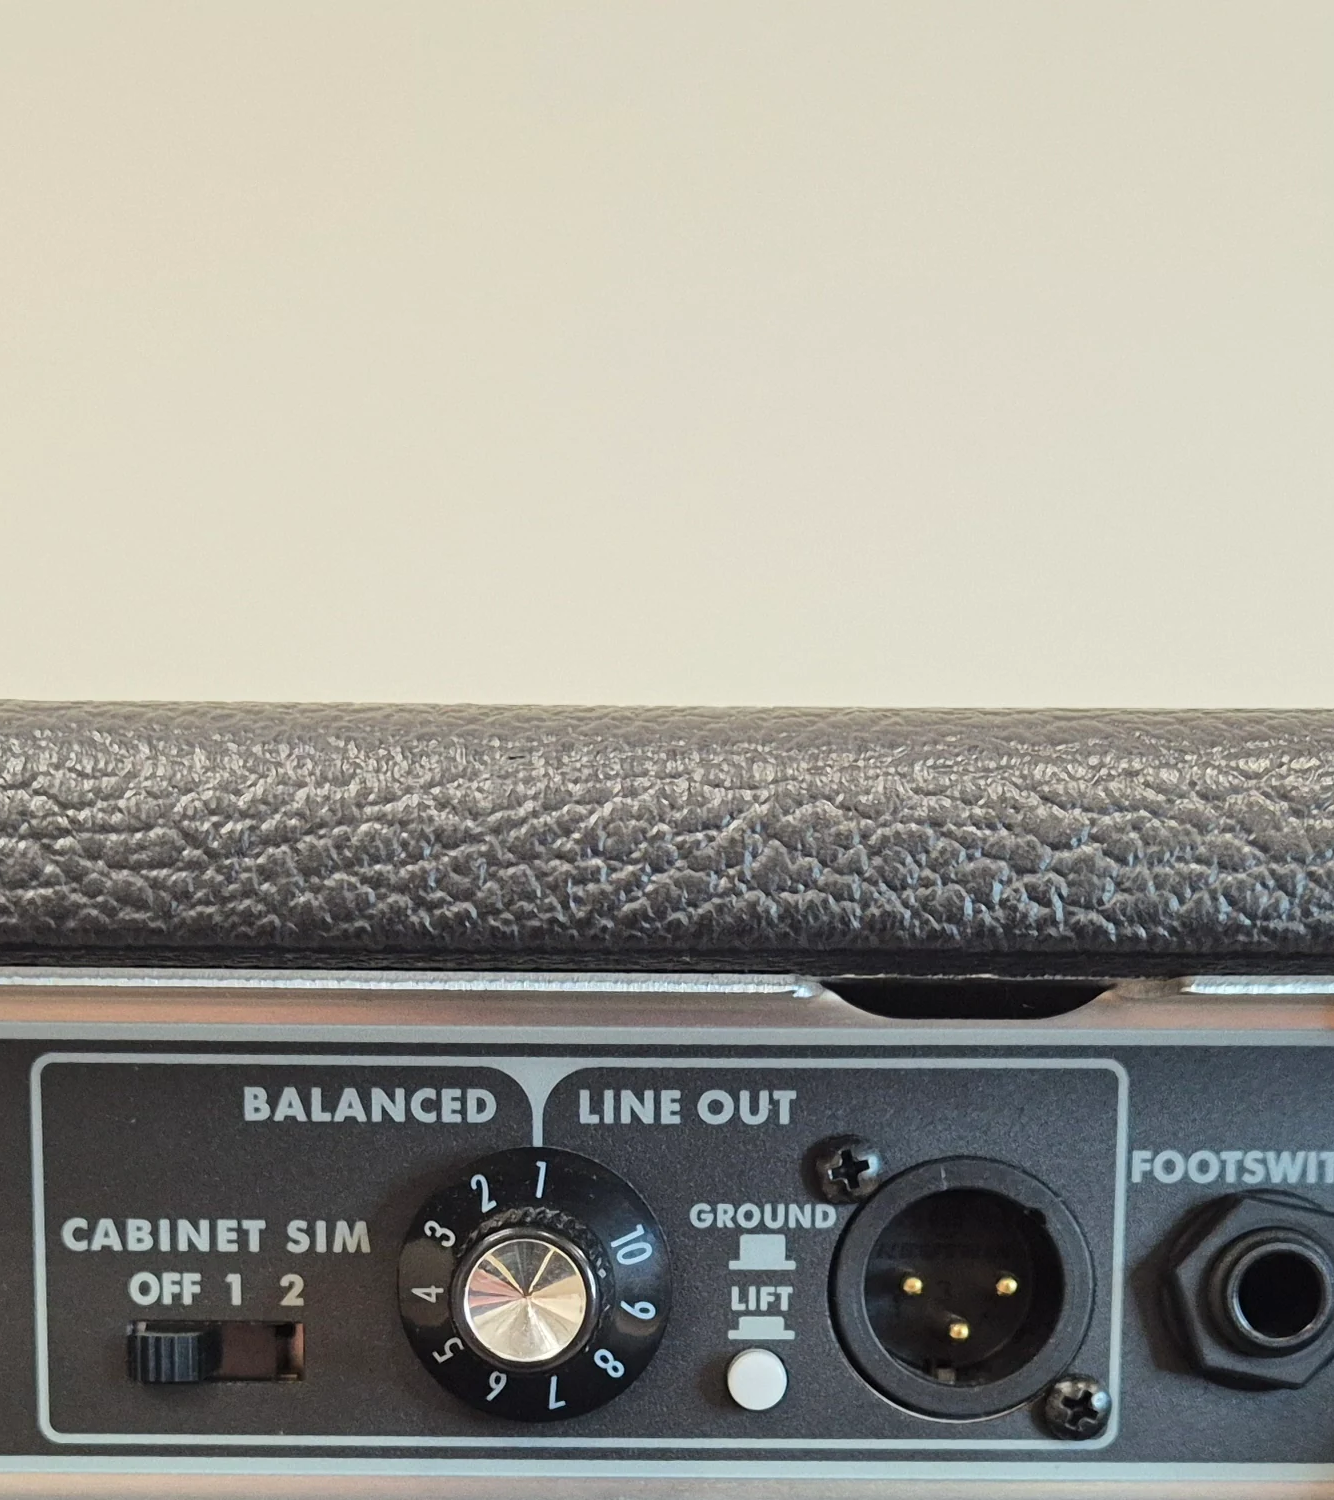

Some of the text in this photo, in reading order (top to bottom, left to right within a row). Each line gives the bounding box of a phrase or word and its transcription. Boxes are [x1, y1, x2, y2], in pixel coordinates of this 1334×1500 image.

[243, 1086, 797, 1126] BALANCED LINE OUT
[470, 1172, 499, 1214] 2
[535, 1160, 549, 1200] 1
[689, 1202, 838, 1230] GROUND
[61, 1217, 371, 1254] CABINET SIM
[424, 1219, 457, 1249] 3
[609, 1223, 655, 1266] 10
[128, 1271, 305, 1307] OFF 1 2
[411, 1283, 446, 1303] 4
[730, 1285, 794, 1312] LIFT
[432, 1336, 466, 1366] 5
[593, 1348, 626, 1380] 8
[484, 1370, 508, 1402] 6
[549, 1374, 566, 1411] 7
